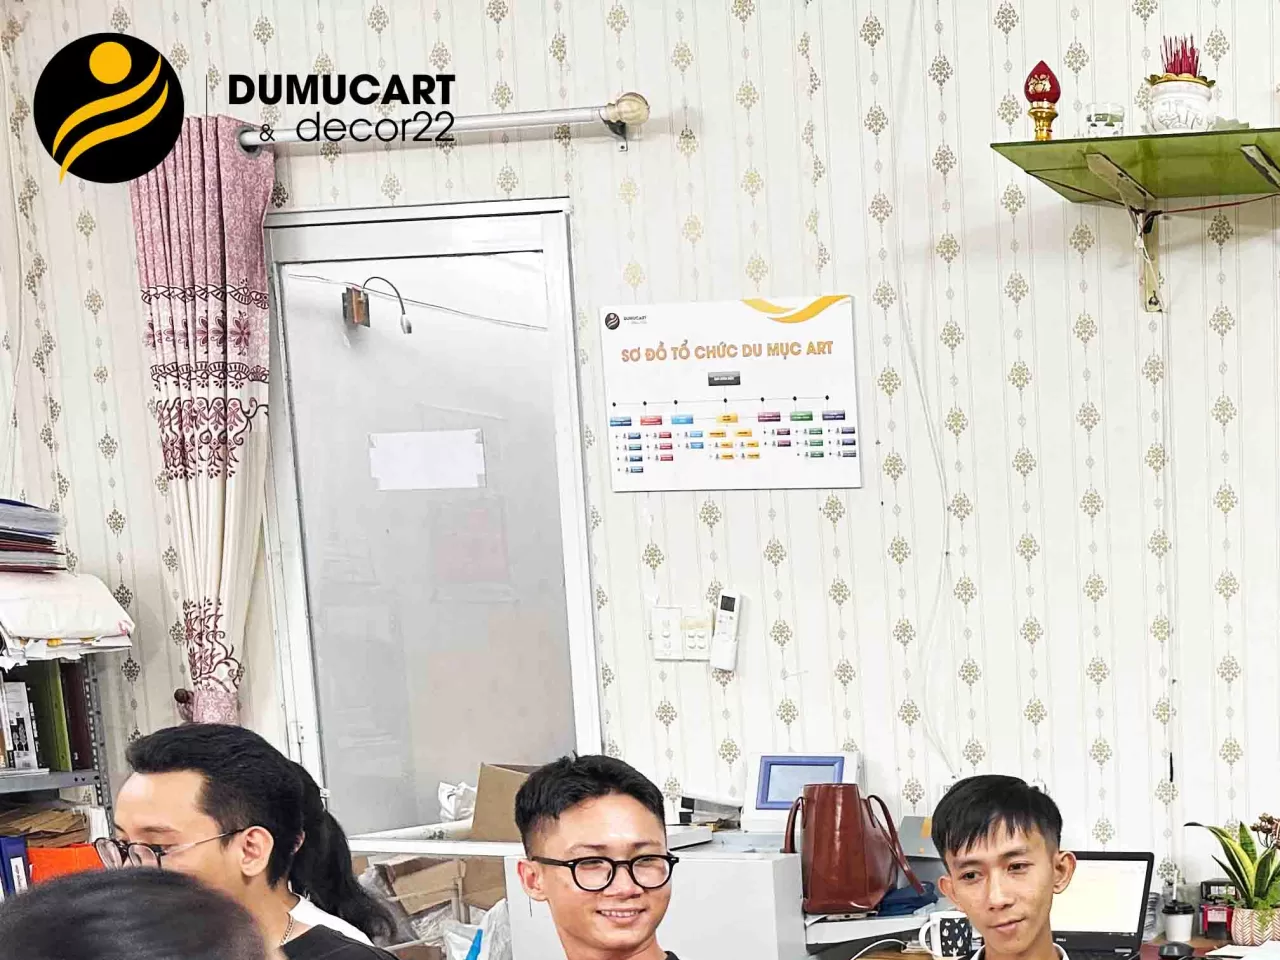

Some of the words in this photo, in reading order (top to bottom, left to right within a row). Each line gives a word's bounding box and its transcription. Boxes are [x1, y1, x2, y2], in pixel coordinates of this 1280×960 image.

[621, 346, 641, 363] SƠ
[645, 341, 667, 361] ĐỒ
[671, 340, 690, 360] TỔ
[694, 341, 738, 359] CHỨC
[742, 343, 762, 357] DU
[766, 341, 802, 359] MỤC
[806, 340, 833, 355] ART
